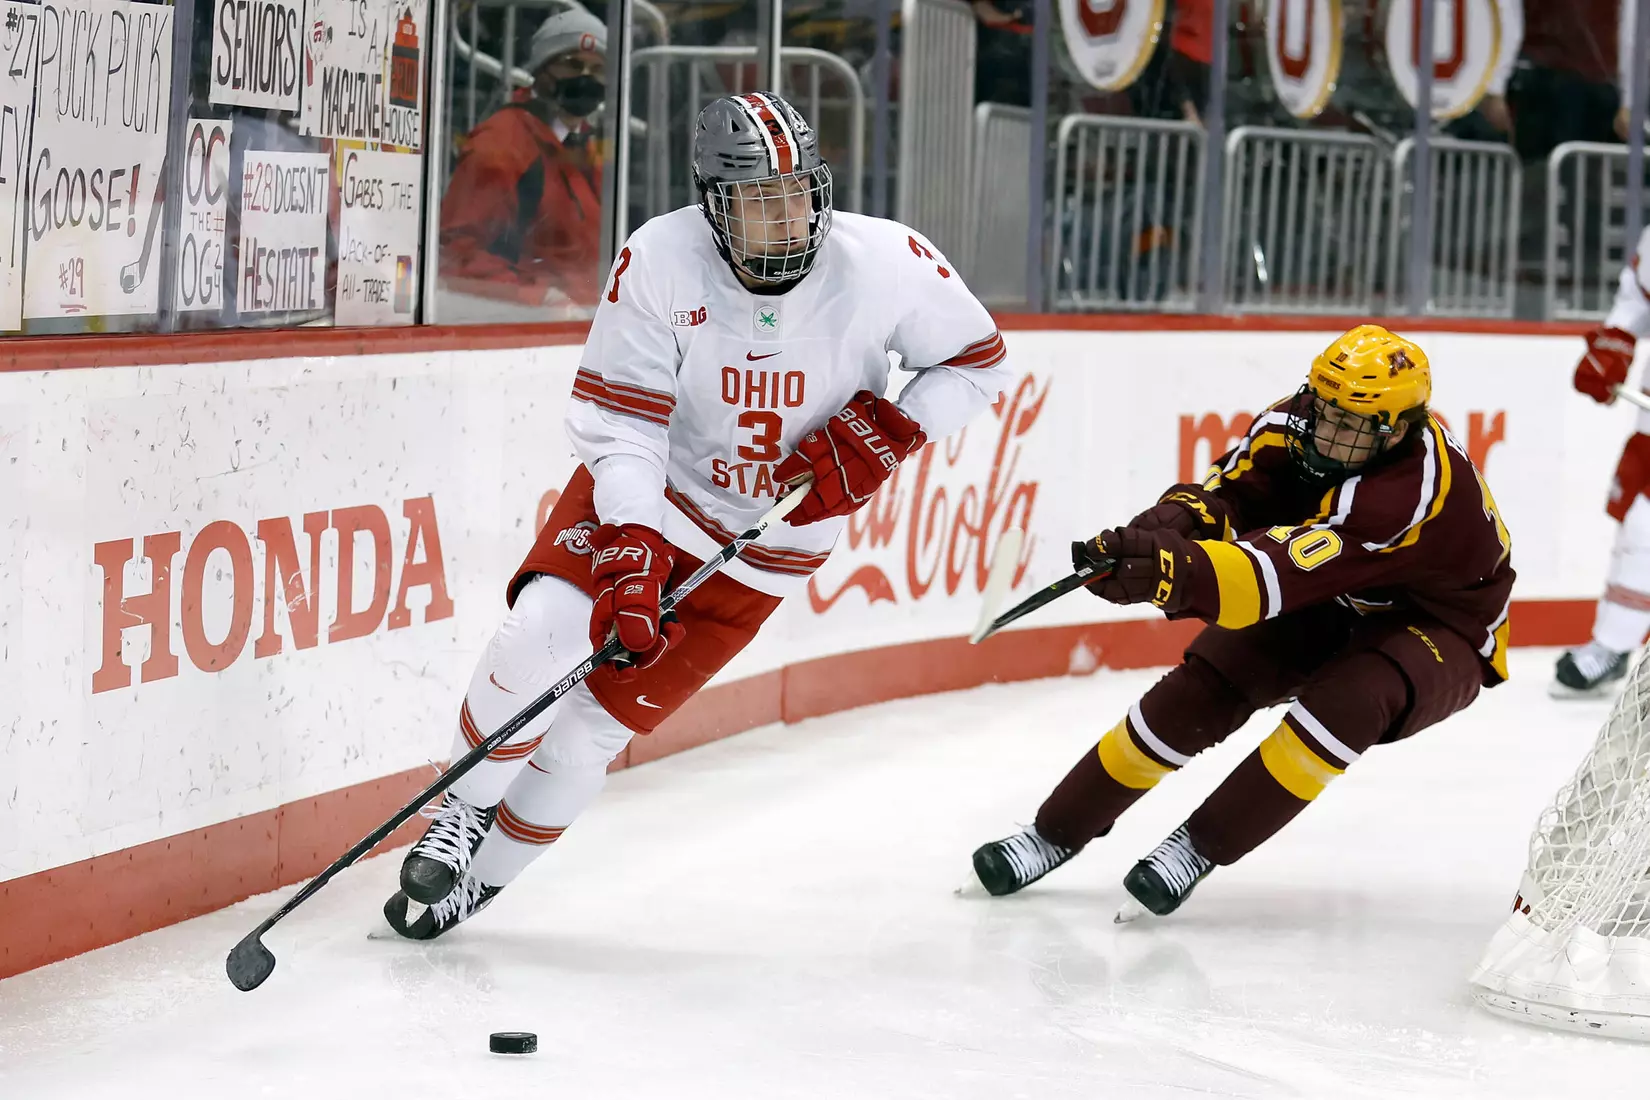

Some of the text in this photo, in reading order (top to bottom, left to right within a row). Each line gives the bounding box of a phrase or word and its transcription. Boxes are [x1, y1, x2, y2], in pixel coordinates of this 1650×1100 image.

[5, 8, 38, 79] #27
[348, 0, 367, 39] IS
[367, 18, 378, 65] A
[104, 10, 169, 134] PUCK
[215, 0, 297, 97] SENIORS
[320, 66, 382, 138] MACHINE
[383, 107, 419, 147] HOUSE
[186, 122, 226, 206] OC
[243, 162, 273, 213] #28
[31, 148, 141, 242] GOOSE!
[190, 212, 211, 232] THE
[58, 258, 84, 299] #29
[181, 232, 213, 307] OG
[243, 237, 319, 310] HESITATE
[607, 247, 632, 304] 3
[721, 366, 805, 409] OHIO
[738, 410, 783, 462] 3
[839, 407, 901, 472] BAUER
[712, 458, 786, 501] STA
[591, 546, 644, 575] UER
[91, 495, 455, 695] HONDA
[553, 660, 593, 698] BAUER
